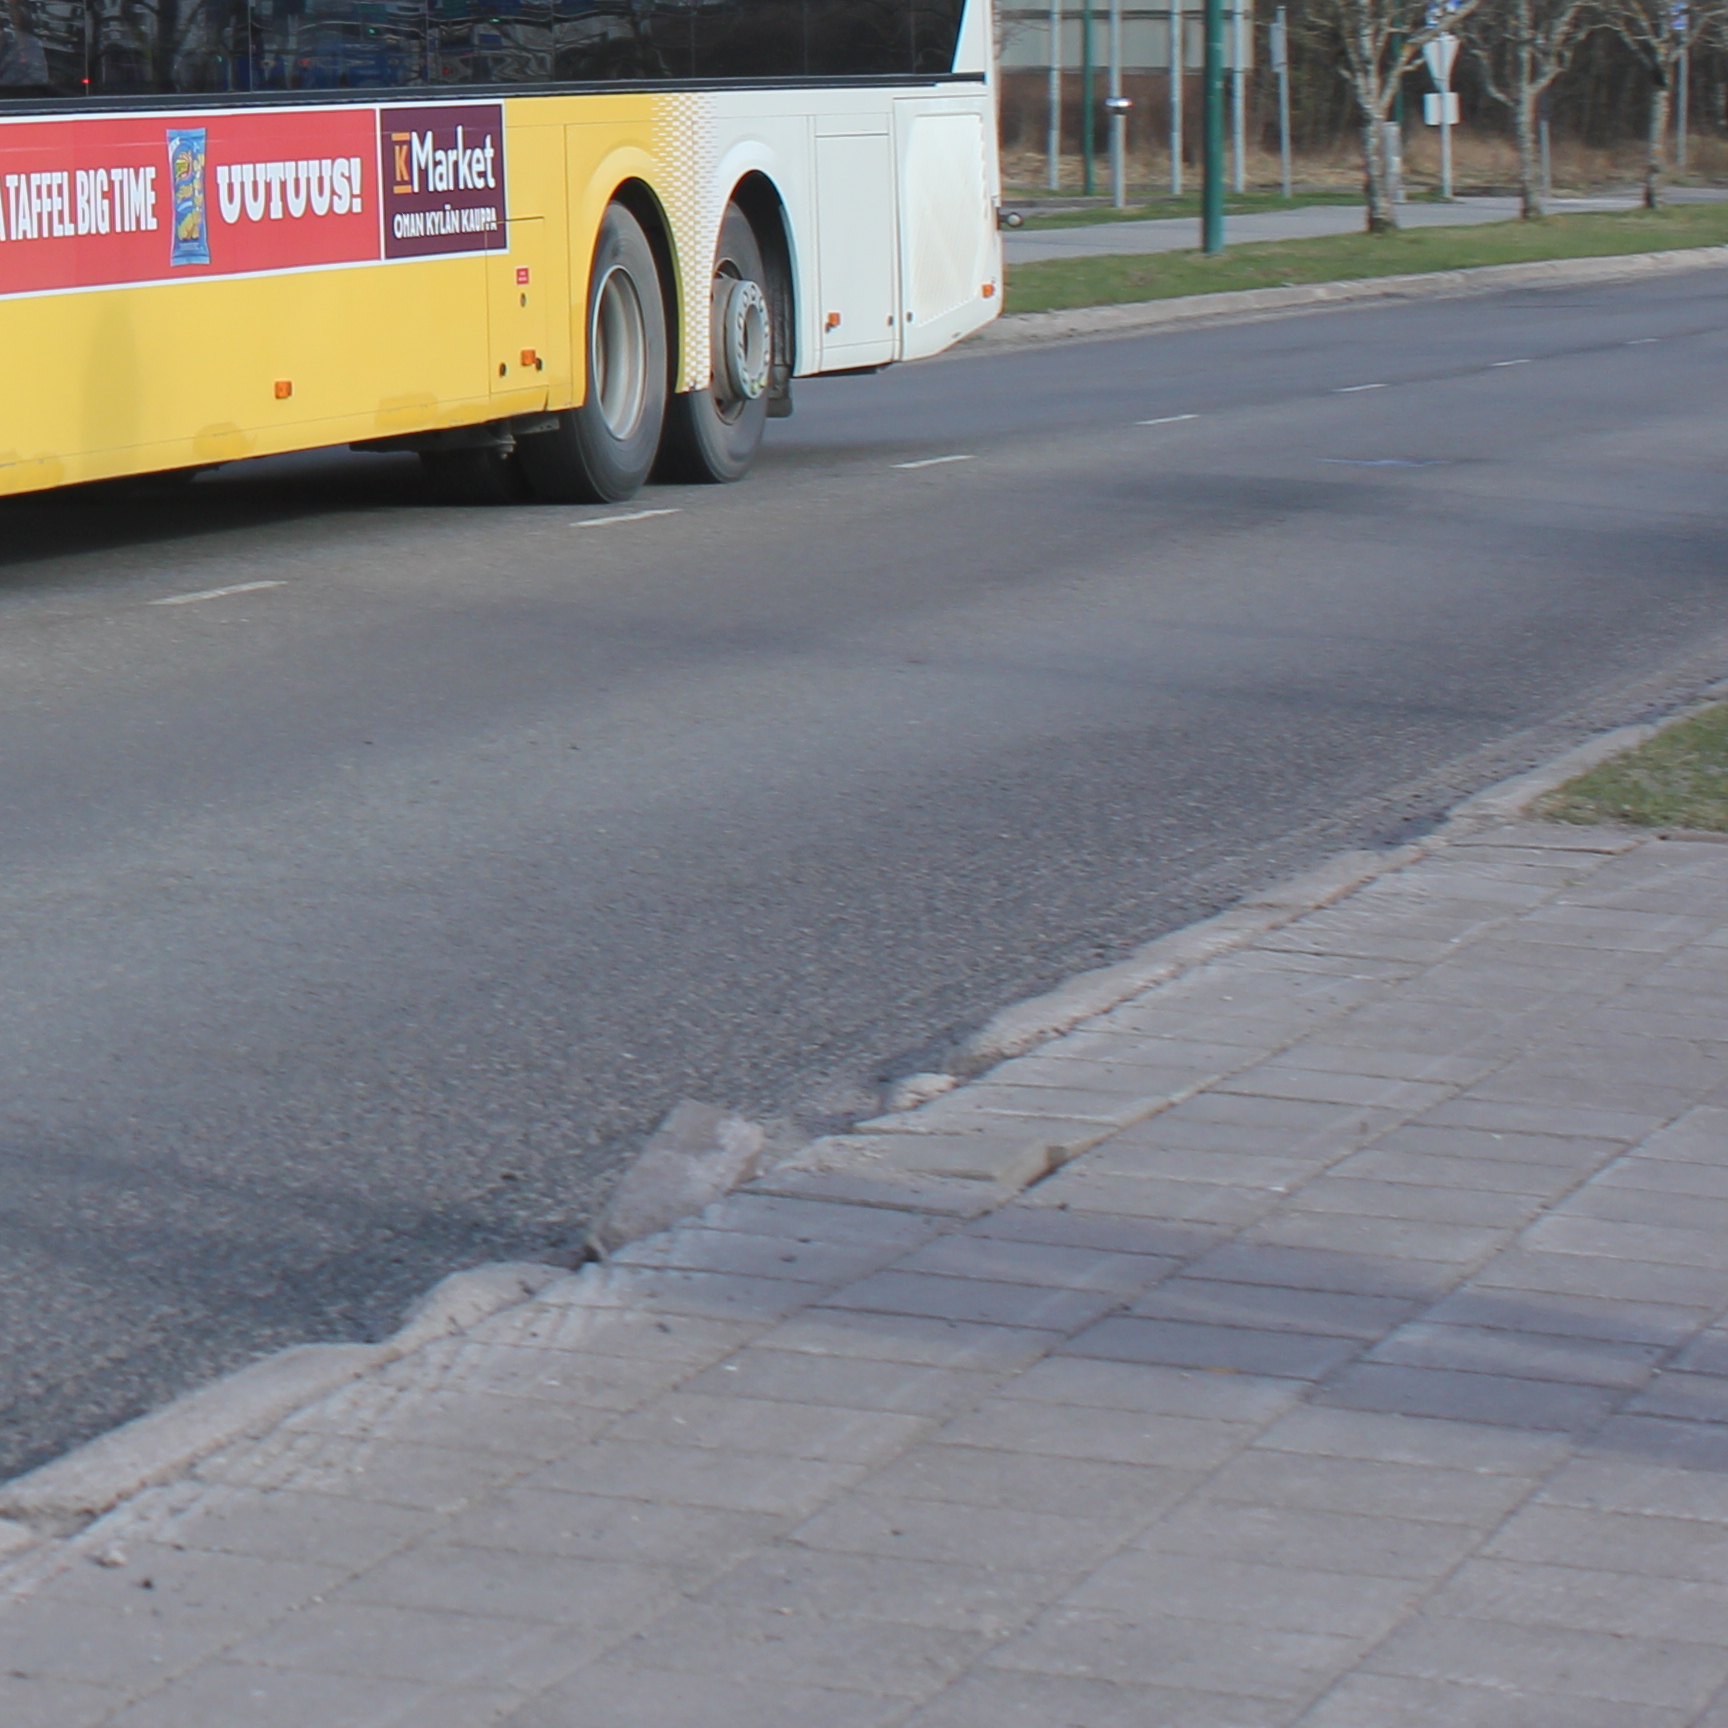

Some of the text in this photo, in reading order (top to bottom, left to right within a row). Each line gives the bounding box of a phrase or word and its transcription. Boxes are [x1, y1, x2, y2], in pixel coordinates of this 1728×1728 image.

[216, 157, 363, 224] UUTUUS!
[394, 125, 496, 193] K Market
[6, 171, 75, 240] TAFFEL
[76, 168, 110, 235] BIG
[111, 166, 158, 232] TIME
[393, 203, 498, 239] OMAN KYLÄN KAUPPA
